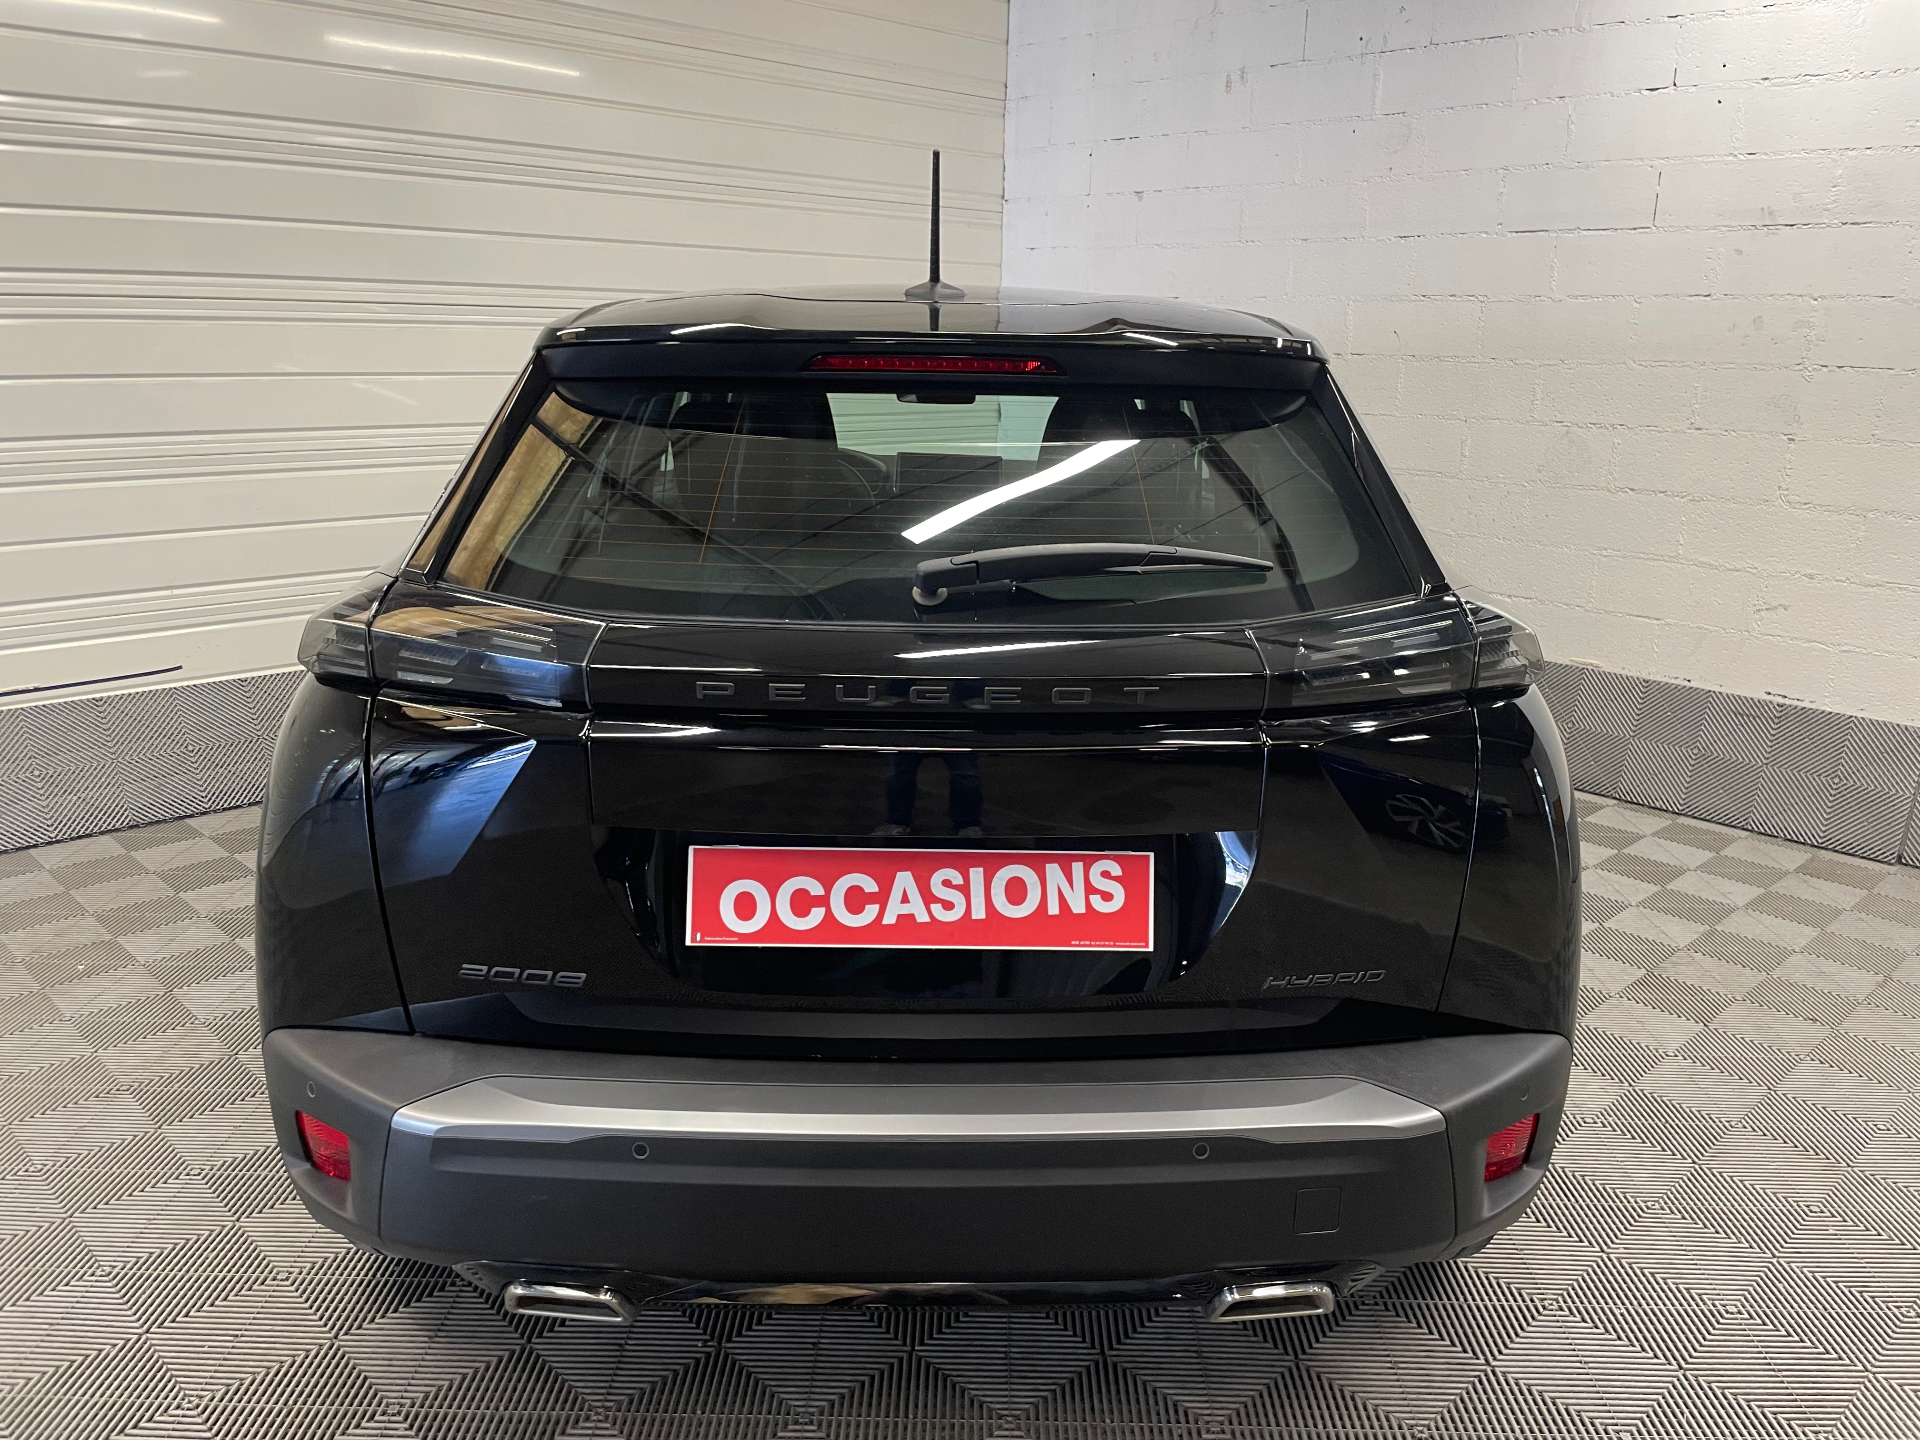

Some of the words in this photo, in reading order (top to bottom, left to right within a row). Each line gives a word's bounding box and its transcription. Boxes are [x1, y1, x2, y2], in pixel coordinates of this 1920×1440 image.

[695, 681, 1160, 704] PEUGEOT
[718, 859, 1126, 934] OCCASIONS
[458, 963, 587, 988] 2008
[1261, 969, 1387, 991] HYBRID
